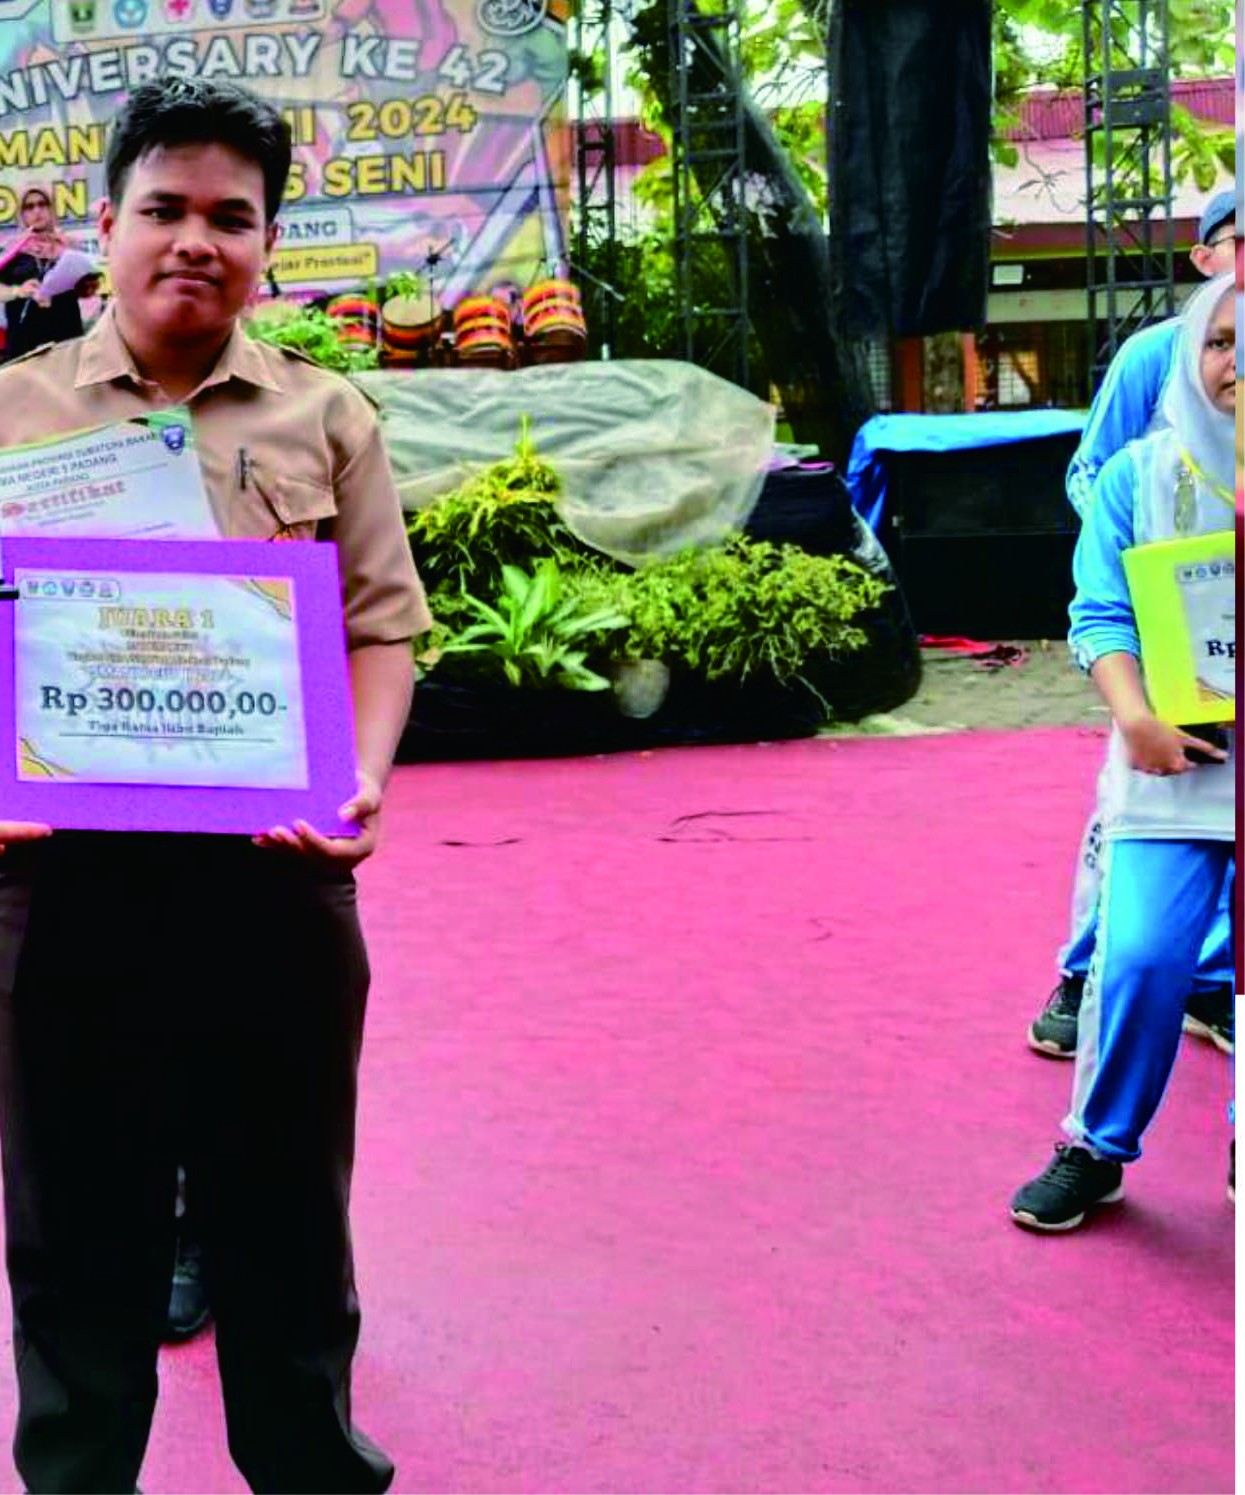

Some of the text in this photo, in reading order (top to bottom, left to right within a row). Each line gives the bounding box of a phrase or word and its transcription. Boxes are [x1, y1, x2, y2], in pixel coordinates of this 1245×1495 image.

[341, 35, 420, 81] KE
[439, 43, 511, 95] 42
[346, 92, 479, 141] 2024
[322, 151, 446, 198] SENI
[40, 685, 88, 716] Rp
